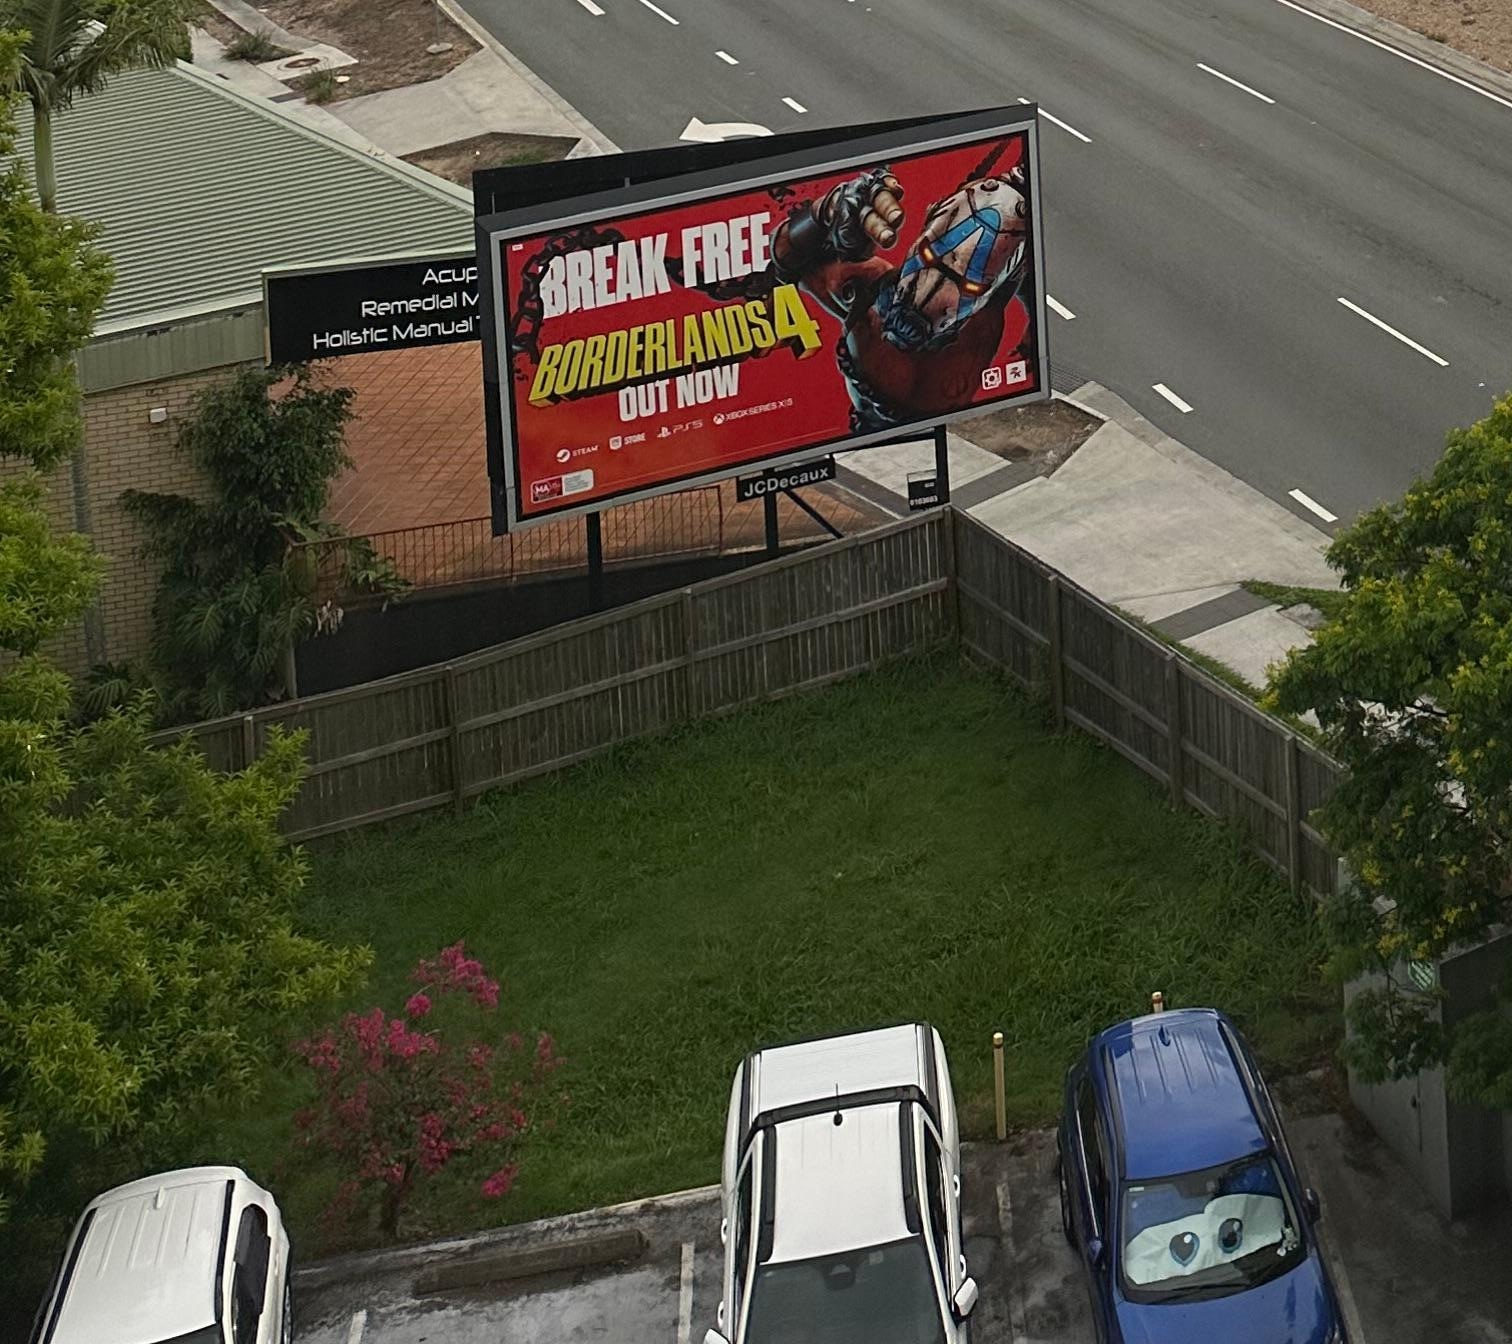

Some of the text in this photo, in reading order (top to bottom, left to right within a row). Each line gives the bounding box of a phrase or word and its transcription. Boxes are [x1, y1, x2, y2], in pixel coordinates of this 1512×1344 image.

[539, 212, 771, 320] BREAK FREE
[361, 292, 457, 318] Remedial
[312, 316, 473, 350] Holistic Manual
[529, 283, 822, 404] BORDERLANDS 4
[618, 363, 740, 422] OUT NOW
[725, 410, 748, 421] XBOX
[749, 402, 777, 415] SERIES
[673, 419, 703, 434] PS5
[572, 445, 599, 458] STEAM
[534, 483, 549, 495] MA
[744, 467, 829, 498] JCDecaux
